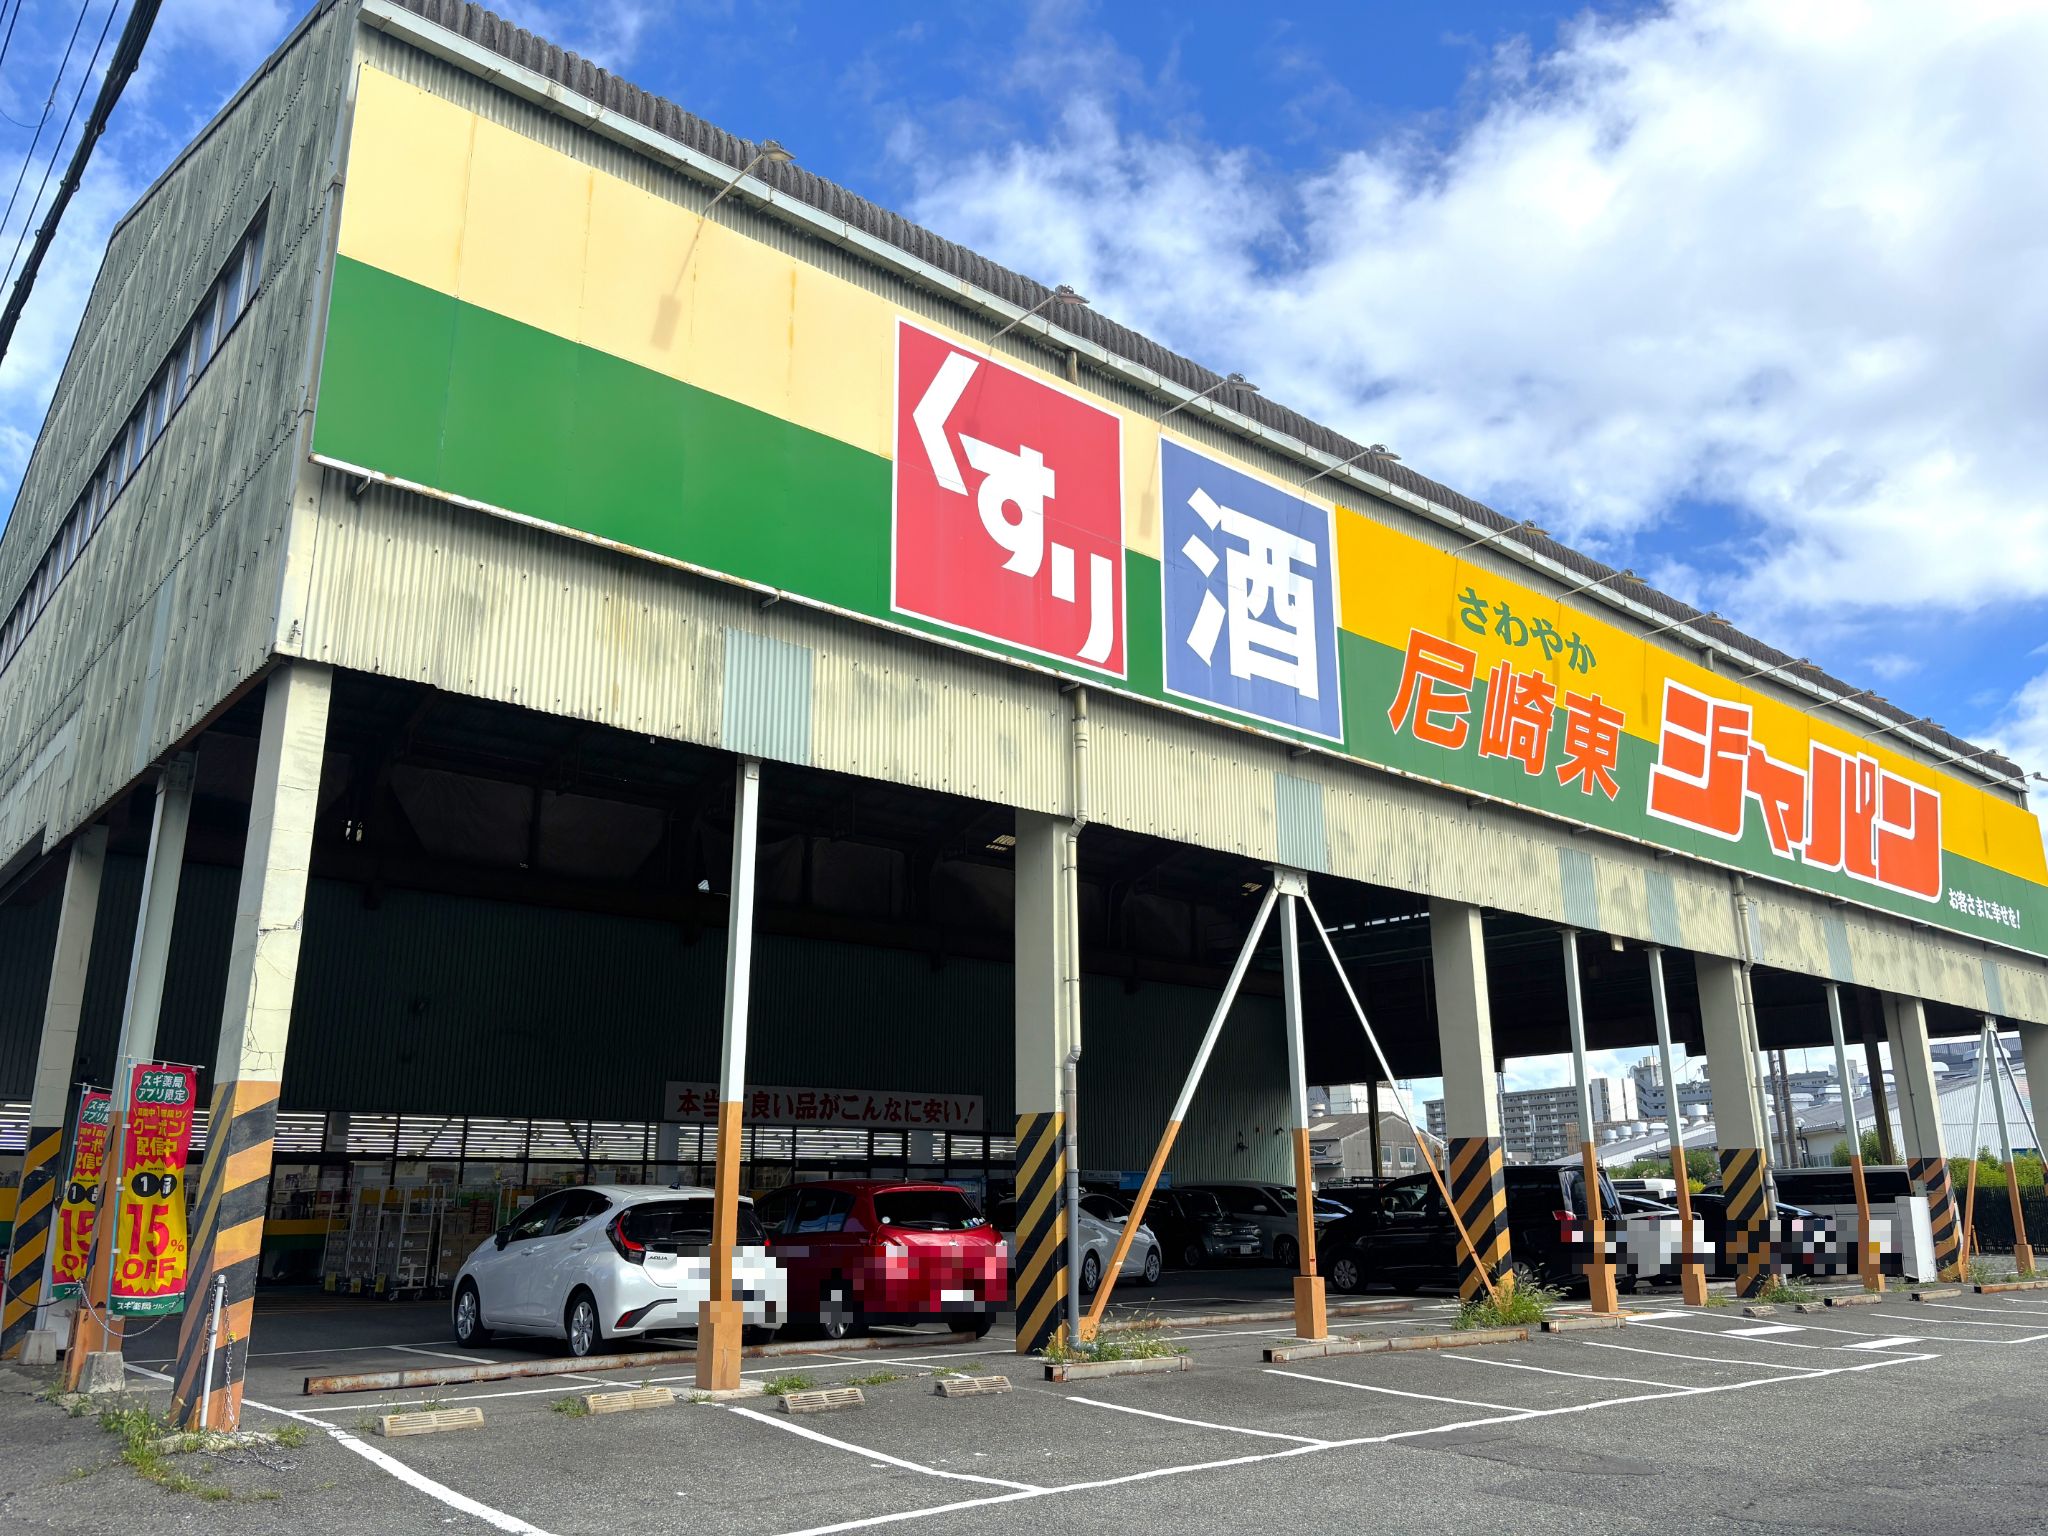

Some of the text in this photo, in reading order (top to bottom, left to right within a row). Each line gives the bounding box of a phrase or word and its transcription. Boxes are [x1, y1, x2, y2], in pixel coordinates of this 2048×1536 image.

[913, 352, 1114, 664] くすり
[1181, 487, 1320, 701] 酒
[1458, 586, 1597, 675] さわやか
[1389, 629, 1942, 904] 尼崎東 ジャパン
[137, 1088, 186, 1102] アプリ限定
[143, 1074, 184, 1088] スギ薬局
[677, 1088, 976, 1125] 本当良い品がこんなに安い!
[133, 1118, 186, 1137] クーポン
[136, 1136, 178, 1158] 配信中
[122, 1257, 177, 1280] OFF
